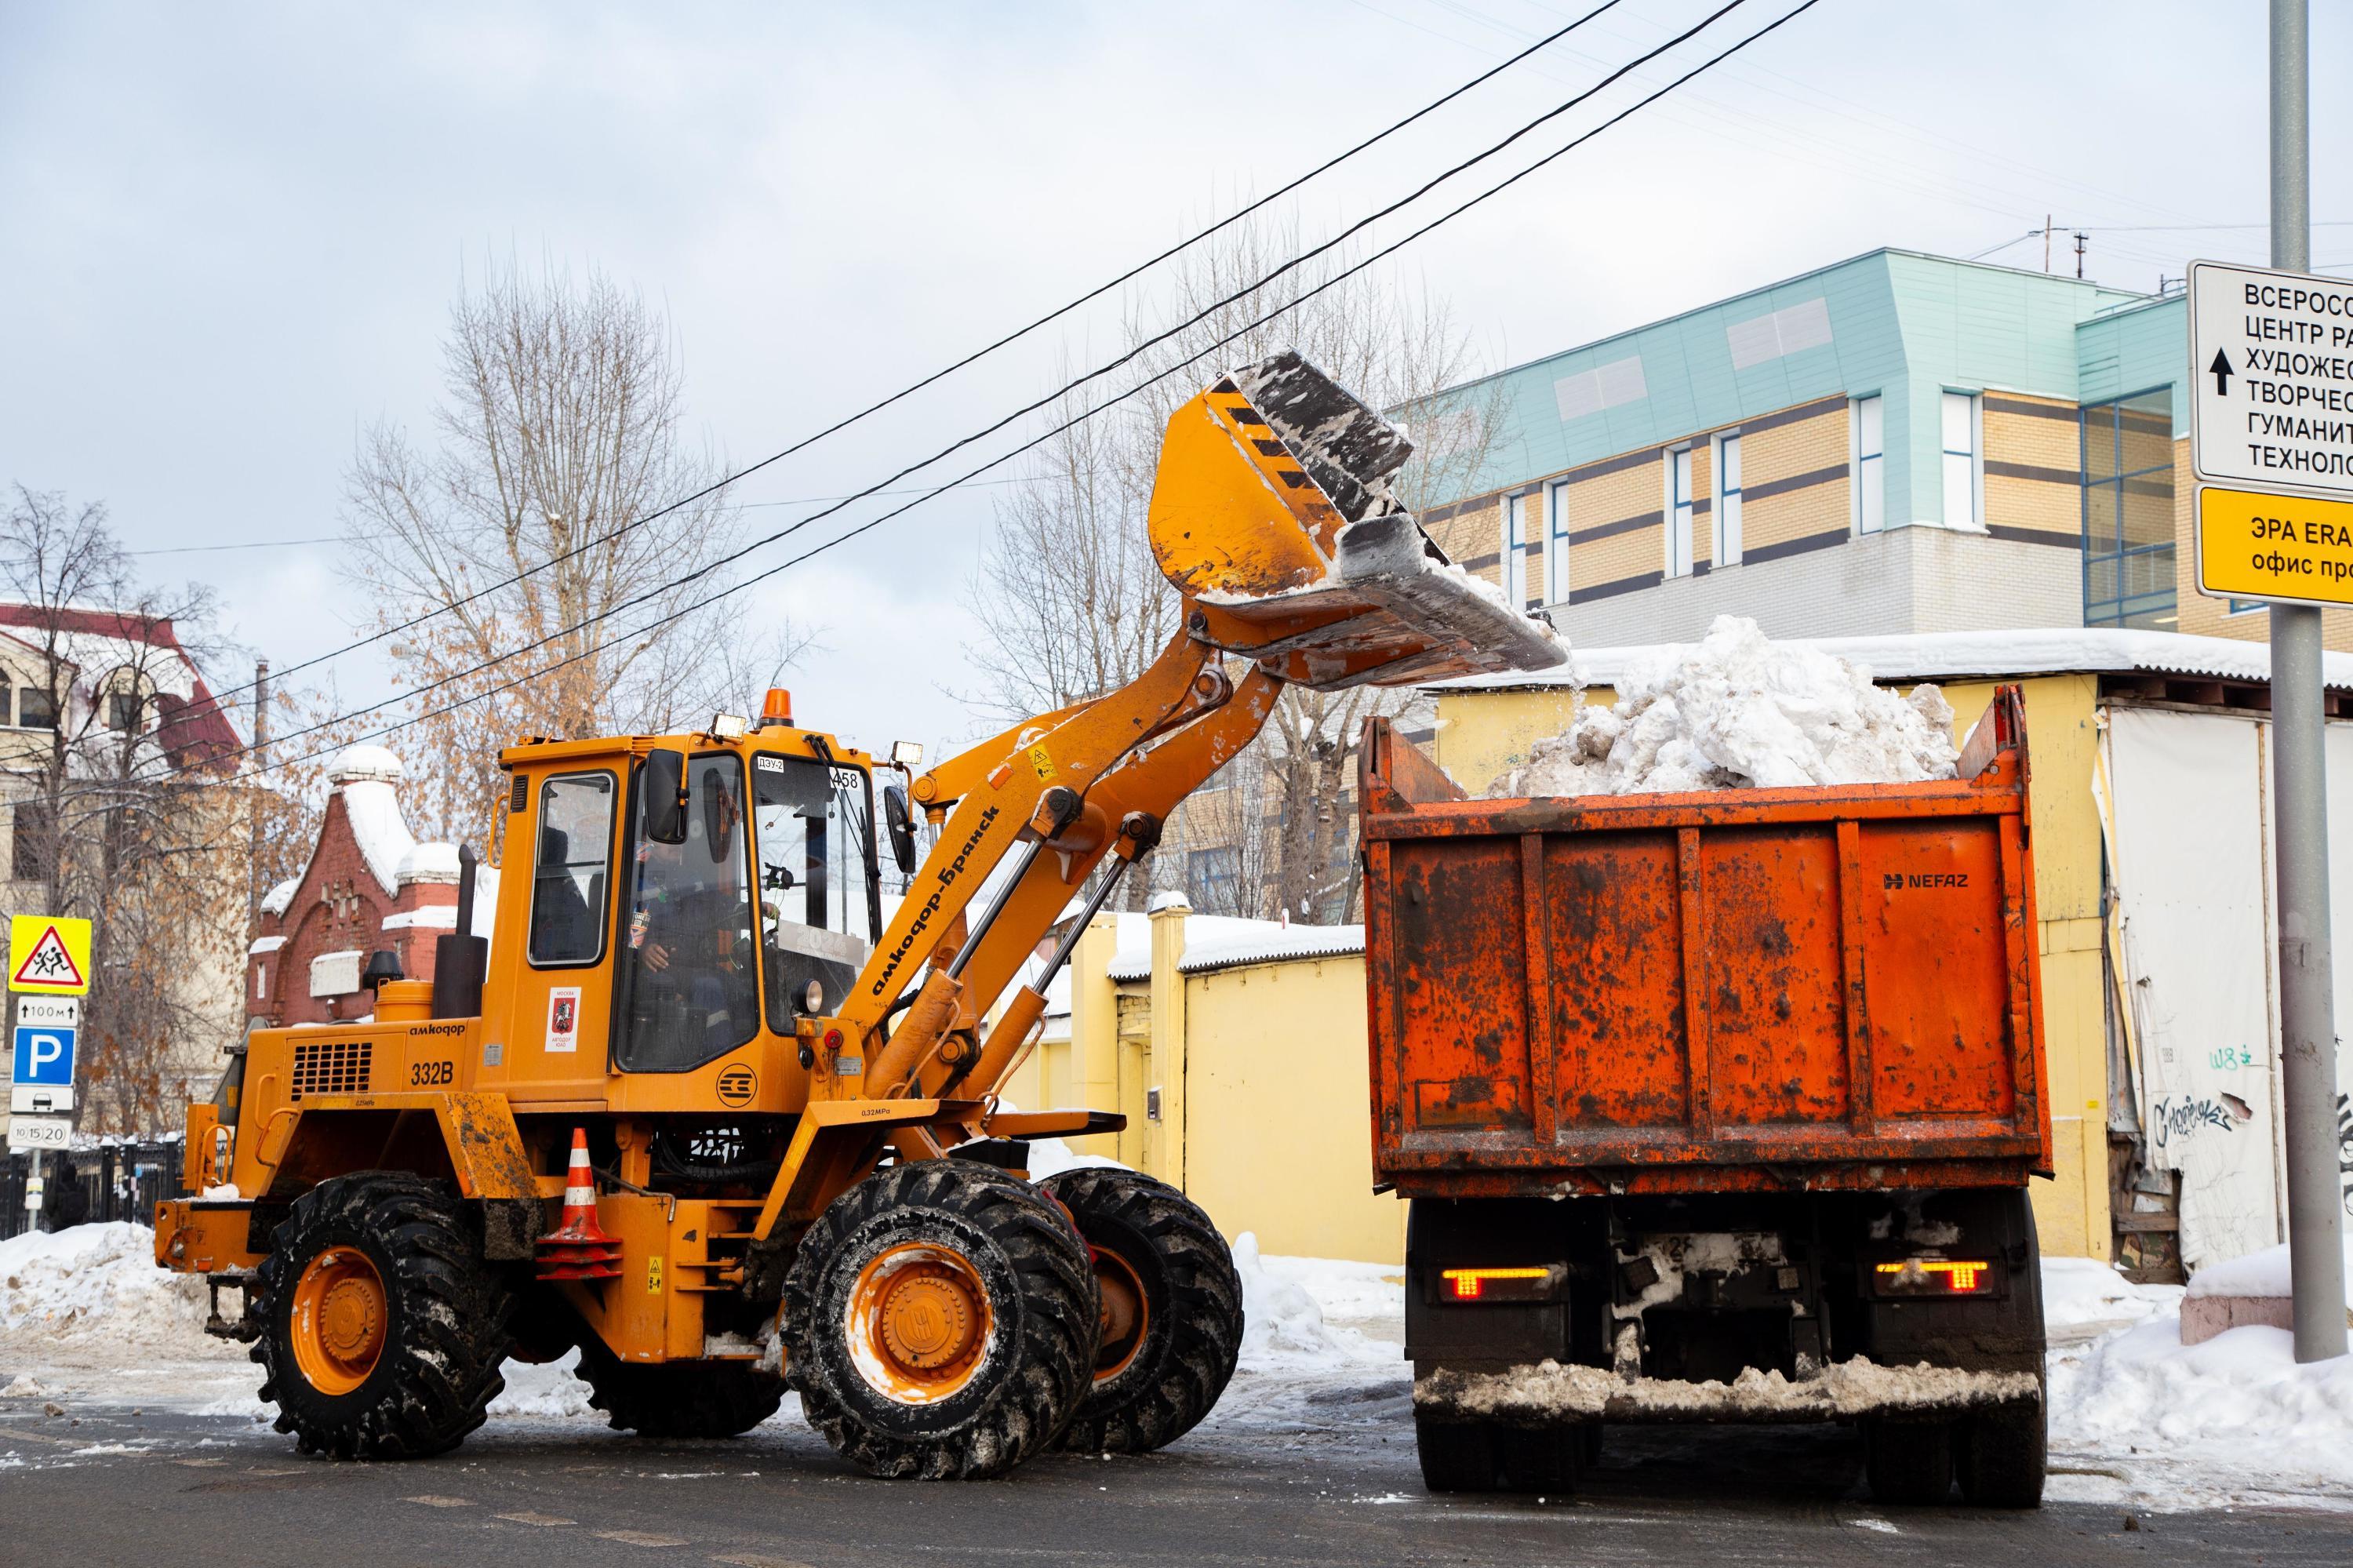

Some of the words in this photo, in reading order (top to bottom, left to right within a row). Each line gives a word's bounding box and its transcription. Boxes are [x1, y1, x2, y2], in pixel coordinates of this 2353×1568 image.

[2246, 315, 2324, 344] ЦЕНТР
[2251, 517, 2297, 542] ЭРА
[2252, 550, 2313, 577] офис
[758, 758, 783, 770] ДЭУ-2
[833, 771, 858, 788] 458
[1908, 875, 1969, 888] NEFAZ
[29, 1035, 62, 1078] P
[16, 1128, 25, 1137] 10
[30, 1128, 40, 1138] 15
[45, 1128, 64, 1140] 20
